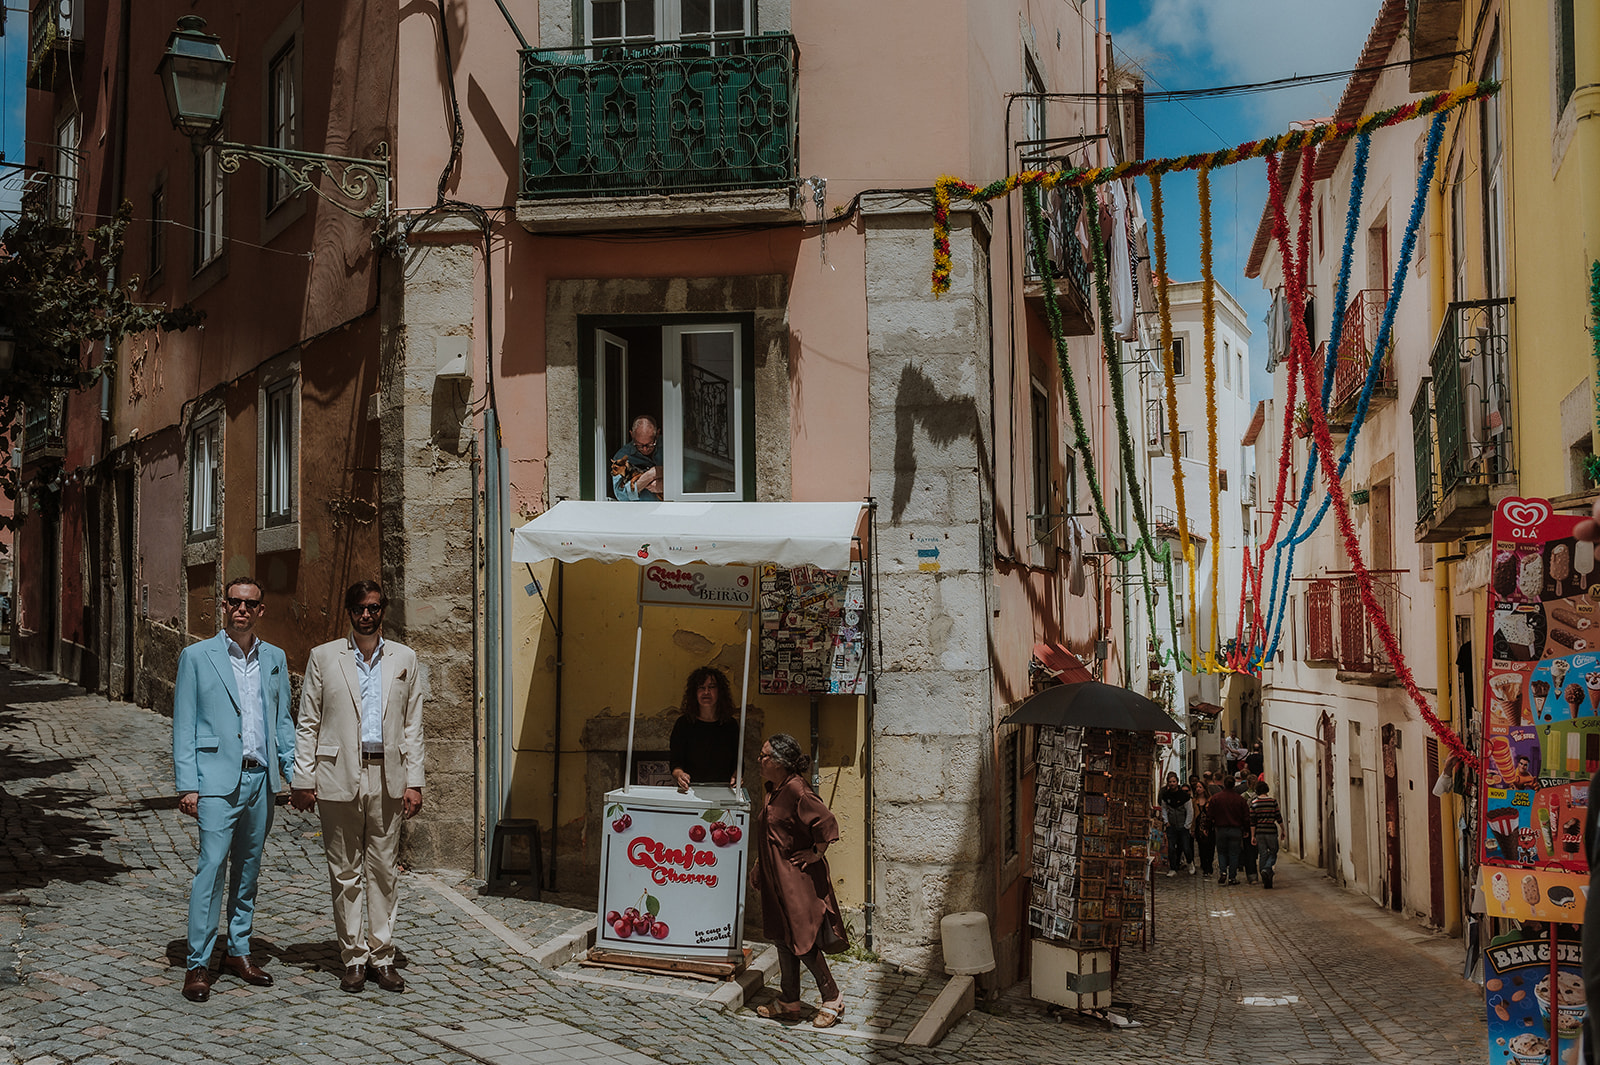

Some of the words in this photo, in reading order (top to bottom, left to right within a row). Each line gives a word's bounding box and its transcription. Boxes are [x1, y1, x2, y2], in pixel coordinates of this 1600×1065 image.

[1511, 526, 1538, 539] OLÁ
[700, 589, 749, 602] BEIRÃO
[627, 836, 718, 870] Ginja
[651, 866, 718, 888] Cherry
[722, 923, 731, 932] of
[696, 932, 731, 944] chocolat
[1493, 944, 1537, 968] BEN
